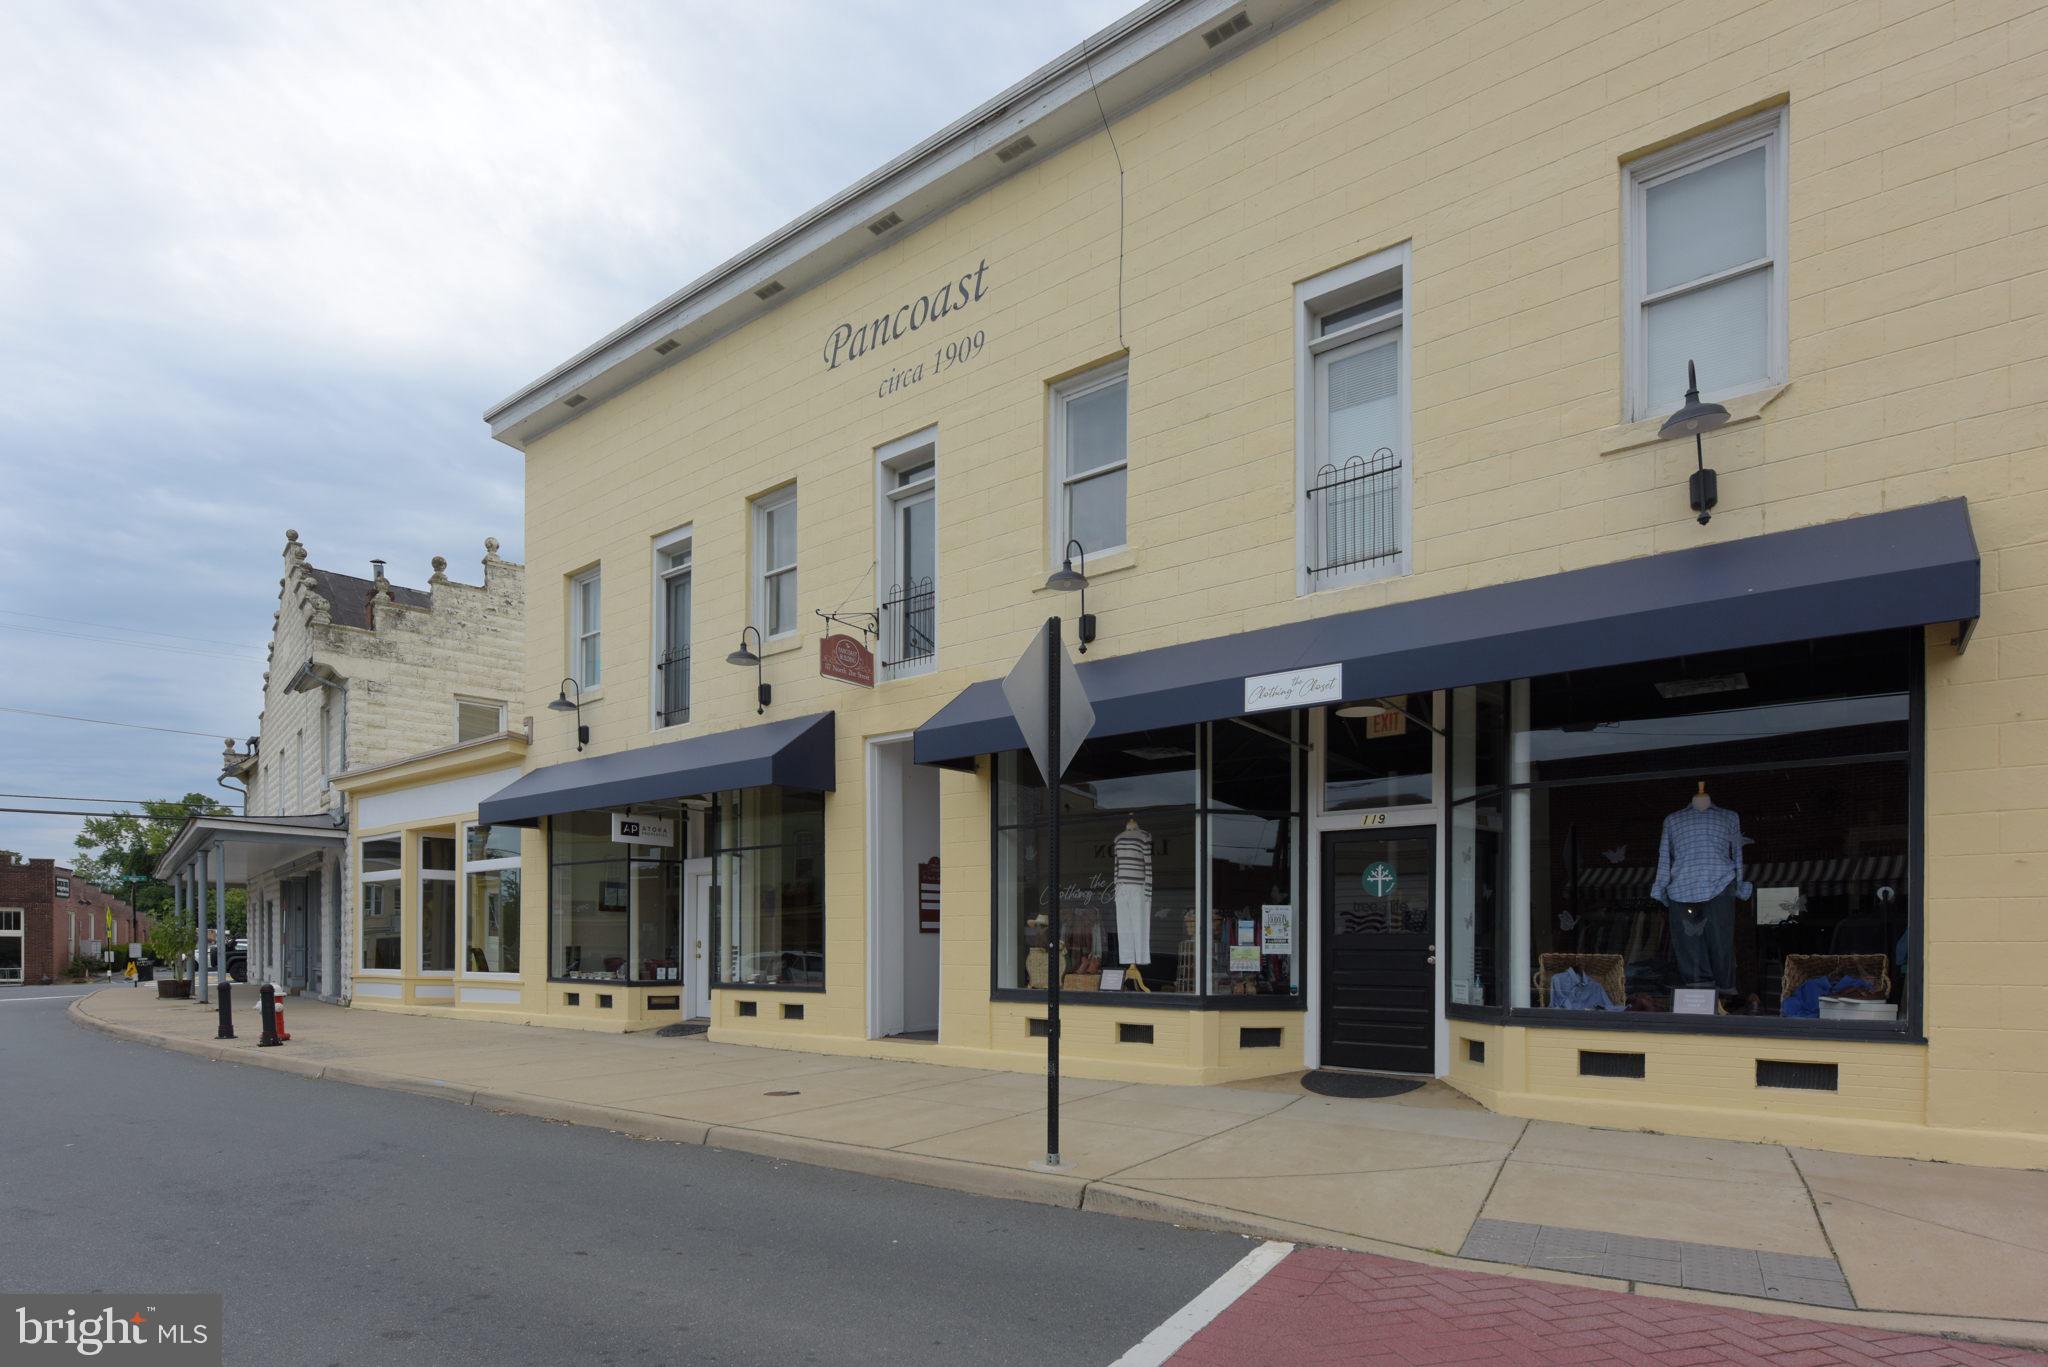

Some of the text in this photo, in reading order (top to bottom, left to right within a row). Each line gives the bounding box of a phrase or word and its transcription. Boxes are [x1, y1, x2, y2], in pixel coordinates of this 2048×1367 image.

[824, 258, 989, 372] Pancoast
[878, 330, 985, 398] circa 1909
[1247, 677, 1336, 704] Clothing Closet
[1373, 711, 1400, 733] EXIT
[623, 824, 638, 834] AP
[1363, 814, 1386, 825] 119
